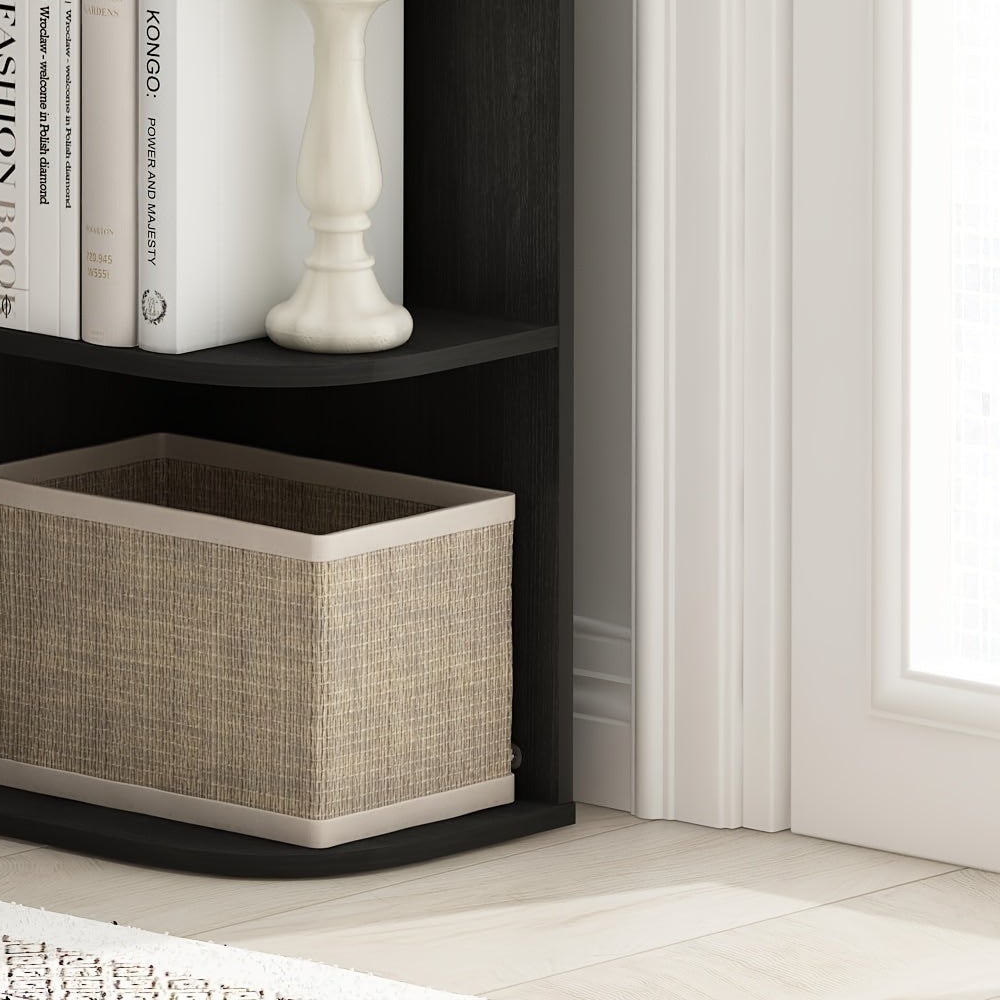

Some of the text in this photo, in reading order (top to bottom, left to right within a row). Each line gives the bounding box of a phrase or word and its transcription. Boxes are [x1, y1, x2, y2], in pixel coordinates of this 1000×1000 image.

[146, 10, 161, 98] KONGO:
[39, 61, 50, 110] welcome
[39, 111, 50, 123] in
[39, 123, 50, 156] Polish
[65, 114, 72, 126] in
[39, 156, 50, 205] diamond
[147, 117, 157, 266] POWER AND MAJESTY
